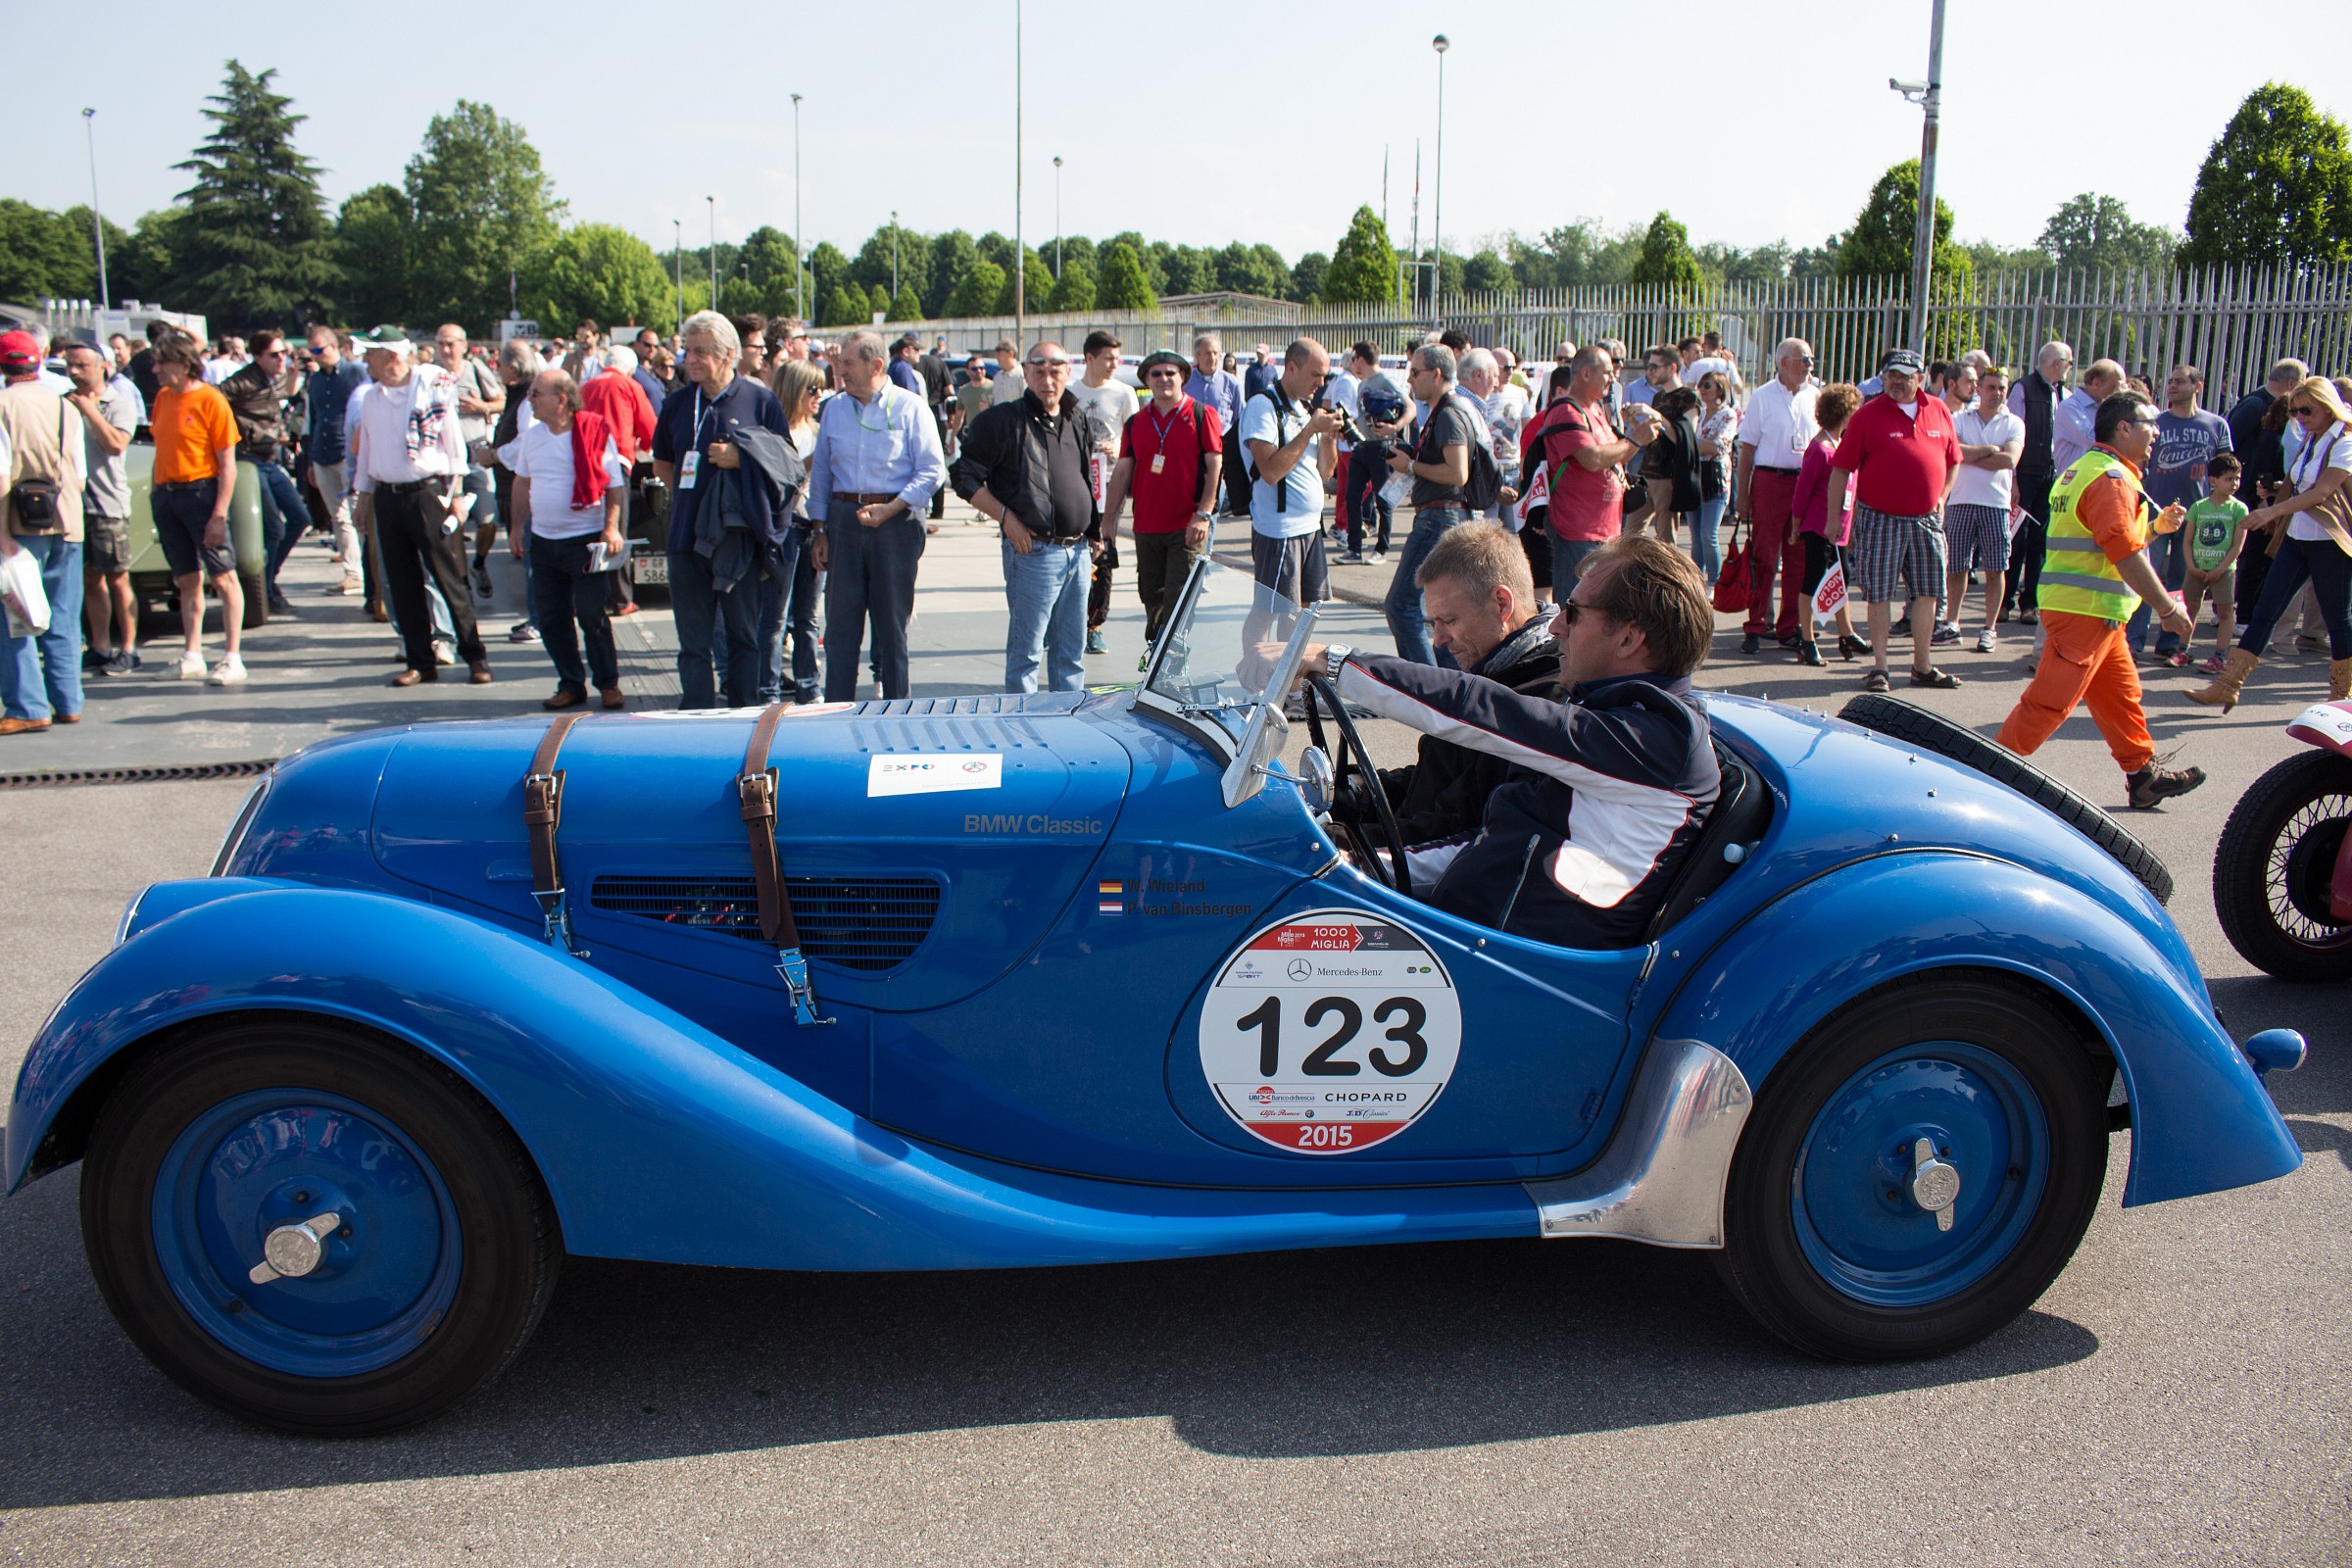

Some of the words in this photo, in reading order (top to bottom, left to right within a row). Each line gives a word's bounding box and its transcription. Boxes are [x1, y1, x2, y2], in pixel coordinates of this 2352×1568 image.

[2160, 428, 2180, 446] ALL
[2182, 427, 2210, 445] STAR
[963, 814, 1023, 833] BMW
[1026, 814, 1102, 834] Classic
[1127, 879, 1145, 893] W.
[1148, 878, 1205, 893] Wieland
[1143, 905, 1167, 915] van
[1314, 927, 1348, 937] 1000
[1310, 940, 1350, 949] MIGLIA
[1317, 967, 1384, 976] Mercedes-Benz
[1236, 996, 1428, 1077] 123
[1324, 1093, 1407, 1102] CHOPARD
[1298, 1125, 1352, 1147] 2015
